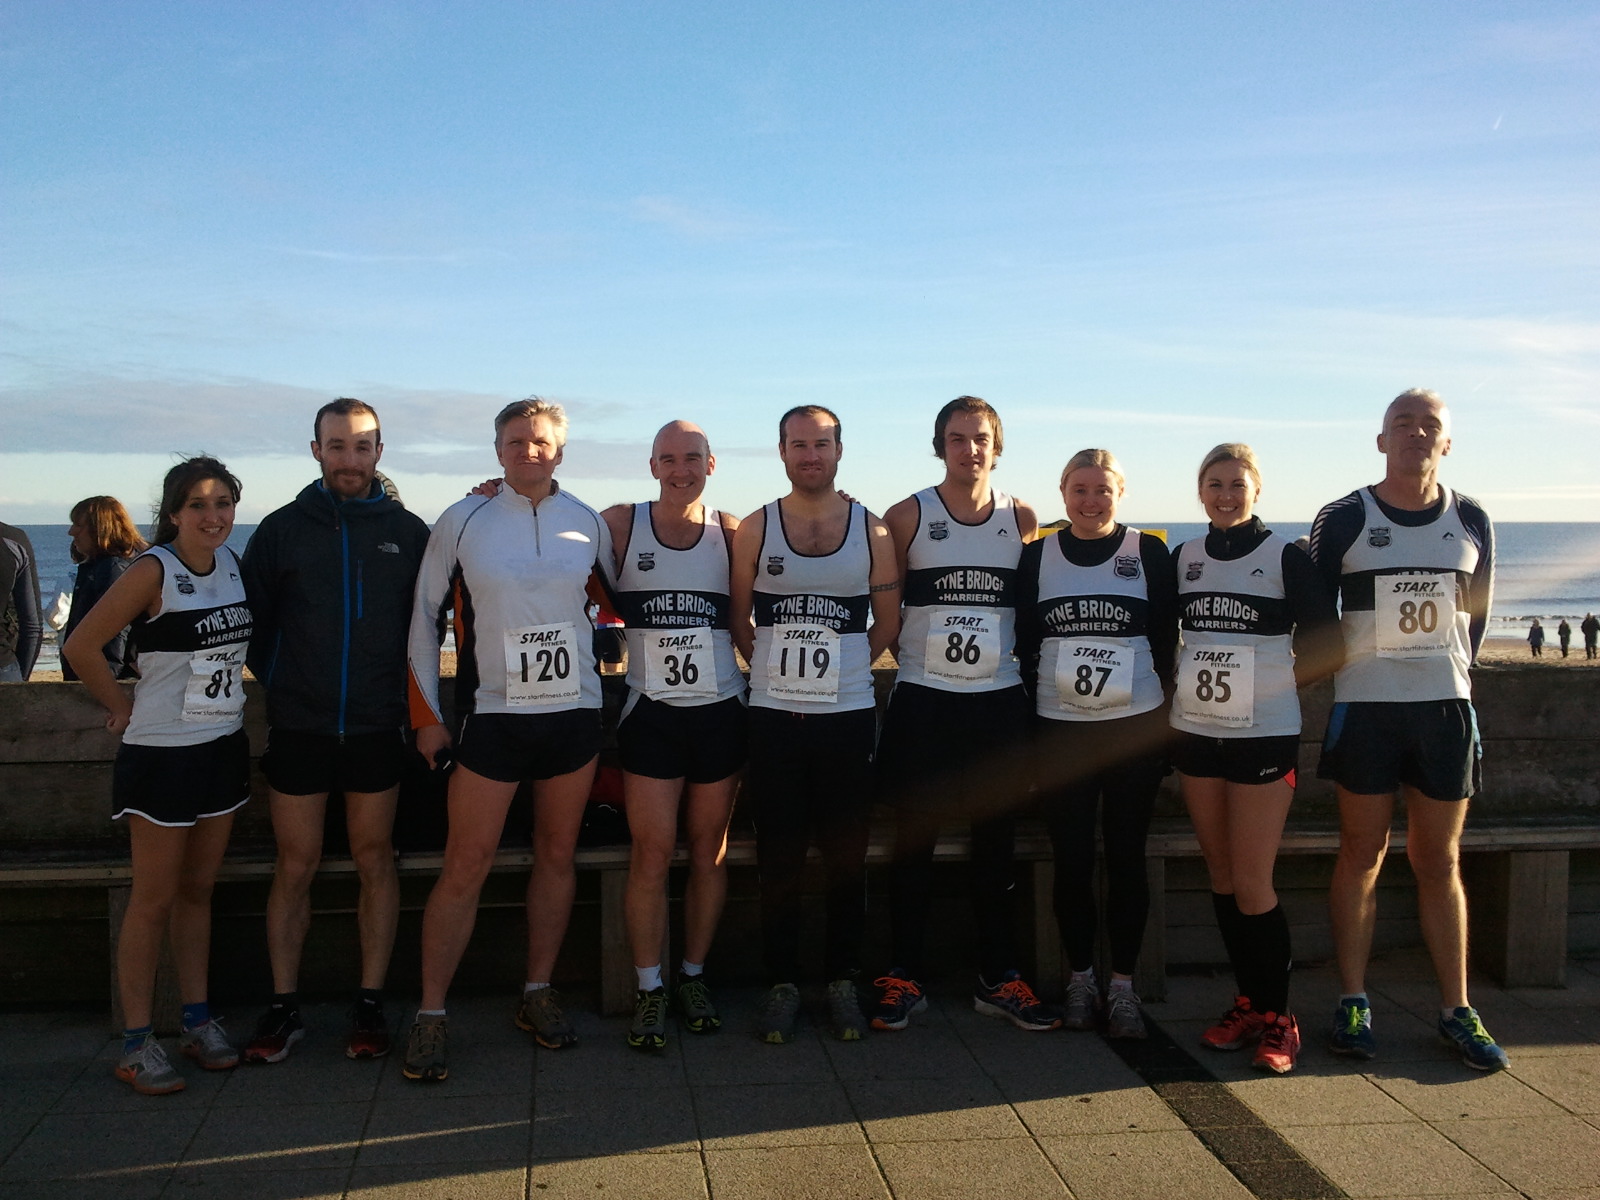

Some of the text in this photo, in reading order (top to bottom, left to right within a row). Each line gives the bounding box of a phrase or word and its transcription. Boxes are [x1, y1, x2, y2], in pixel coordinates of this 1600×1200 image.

[934, 569, 1005, 592] TYNE BRIDGE
[1392, 581, 1440, 593] START
[642, 593, 717, 617] TYNE BRIDGE
[943, 593, 996, 603] HARRIERS
[772, 595, 851, 621] TYNE BRIDGE
[1044, 599, 1132, 627] TYNE BRIDGE
[1185, 596, 1259, 622] TYNE BRIDGE
[194, 610, 226, 634] TYNE
[651, 615, 710, 627] HARRIERS
[944, 616, 984, 627] START
[1398, 600, 1438, 635] 80
[962, 625, 989, 633] FITNESS
[1055, 621, 1120, 633] HARRIERS
[520, 629, 561, 645] START
[658, 634, 697, 649] START
[784, 630, 824, 640] START
[540, 639, 567, 648] FITNESS
[676, 644, 703, 652] FITNESS
[800, 639, 829, 647] FITNESS
[945, 632, 981, 665] 86
[1073, 646, 1116, 660] START
[1193, 650, 1235, 663] START
[520, 646, 570, 683] 120
[780, 647, 830, 679] 119
[1092, 658, 1121, 666] FITNESS
[1210, 661, 1241, 669] FITNESS
[664, 653, 699, 687] 36
[205, 669, 232, 699] 81
[1074, 664, 1113, 698] 87
[1195, 669, 1232, 704] 85
[510, 690, 579, 701] www.startfitness.co.uk
